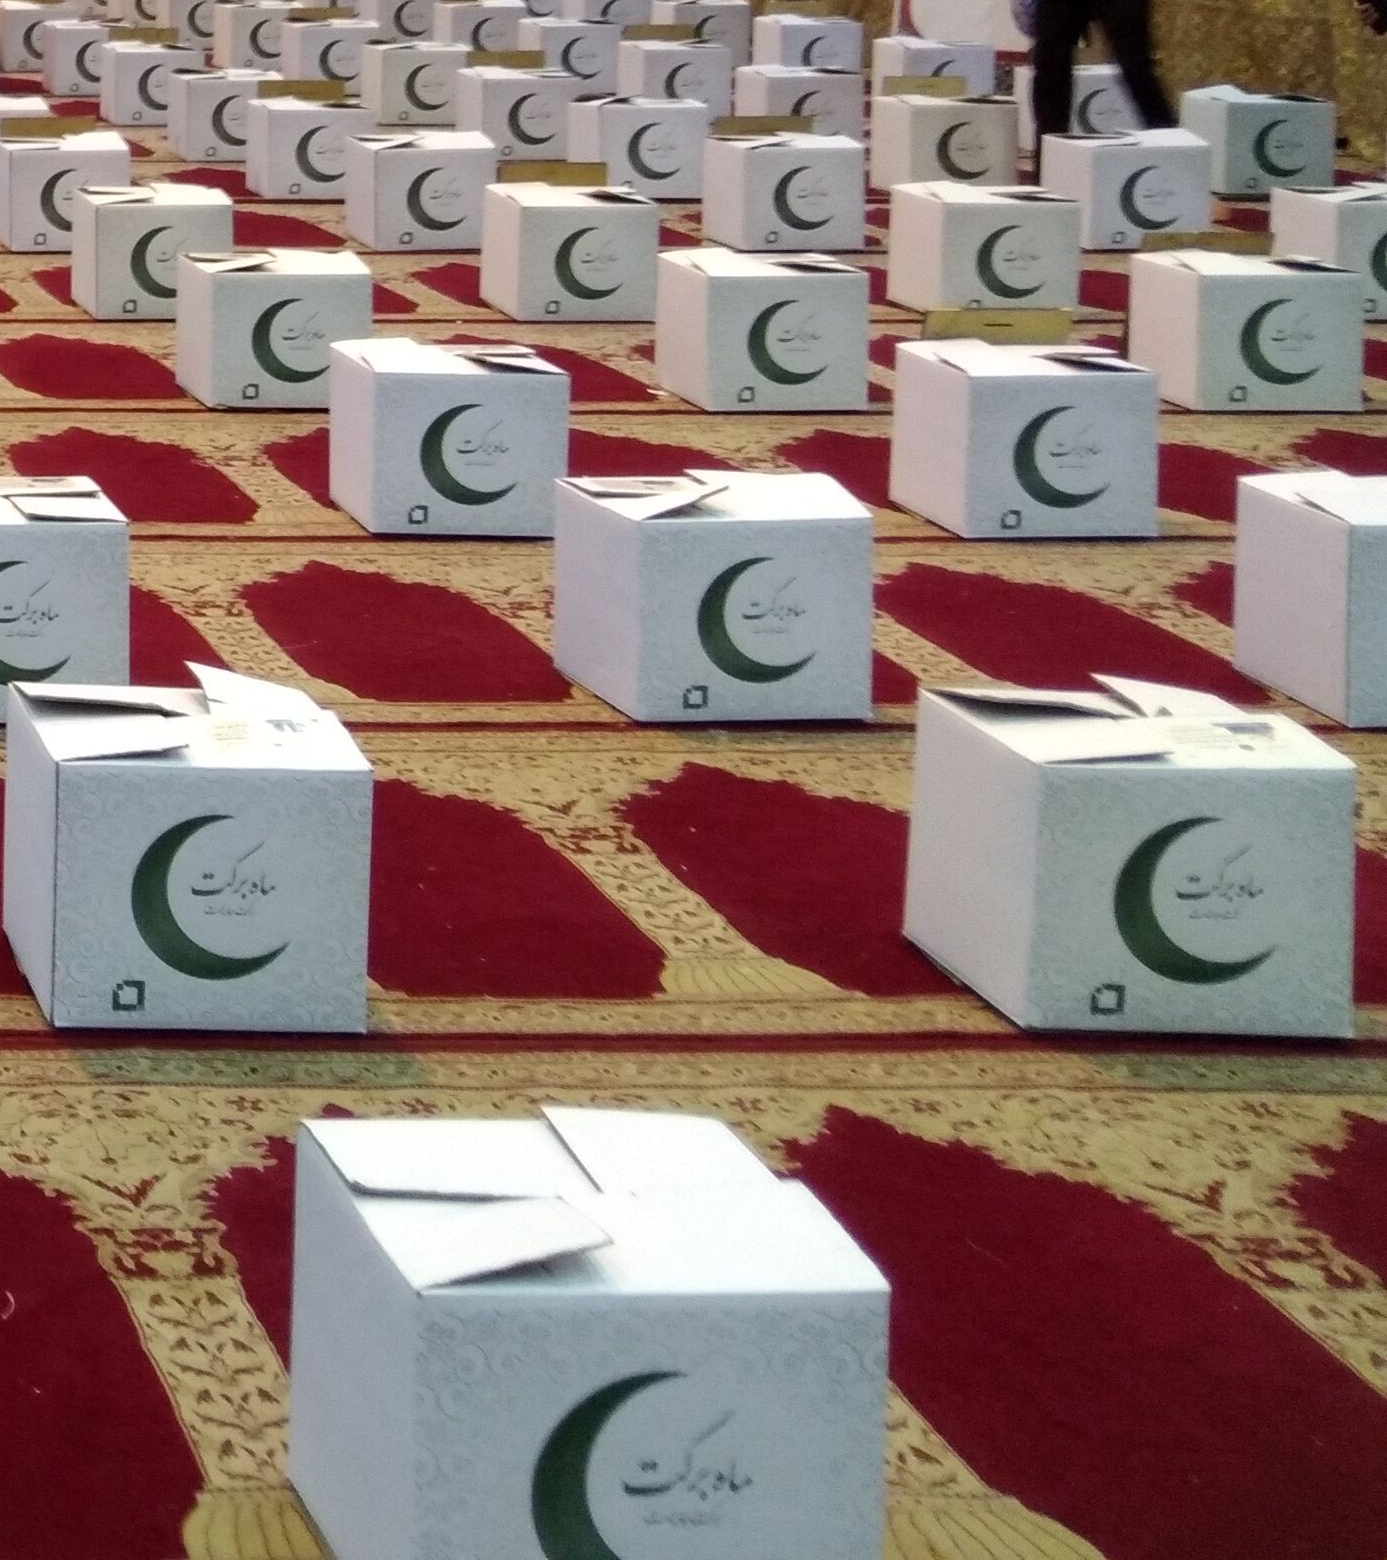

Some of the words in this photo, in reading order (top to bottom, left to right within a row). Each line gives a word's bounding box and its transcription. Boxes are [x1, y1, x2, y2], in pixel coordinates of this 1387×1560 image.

[191, 841, 265, 900] برکت
[249, 872, 275, 896] ماه
[621, 1409, 736, 1502] برکت
